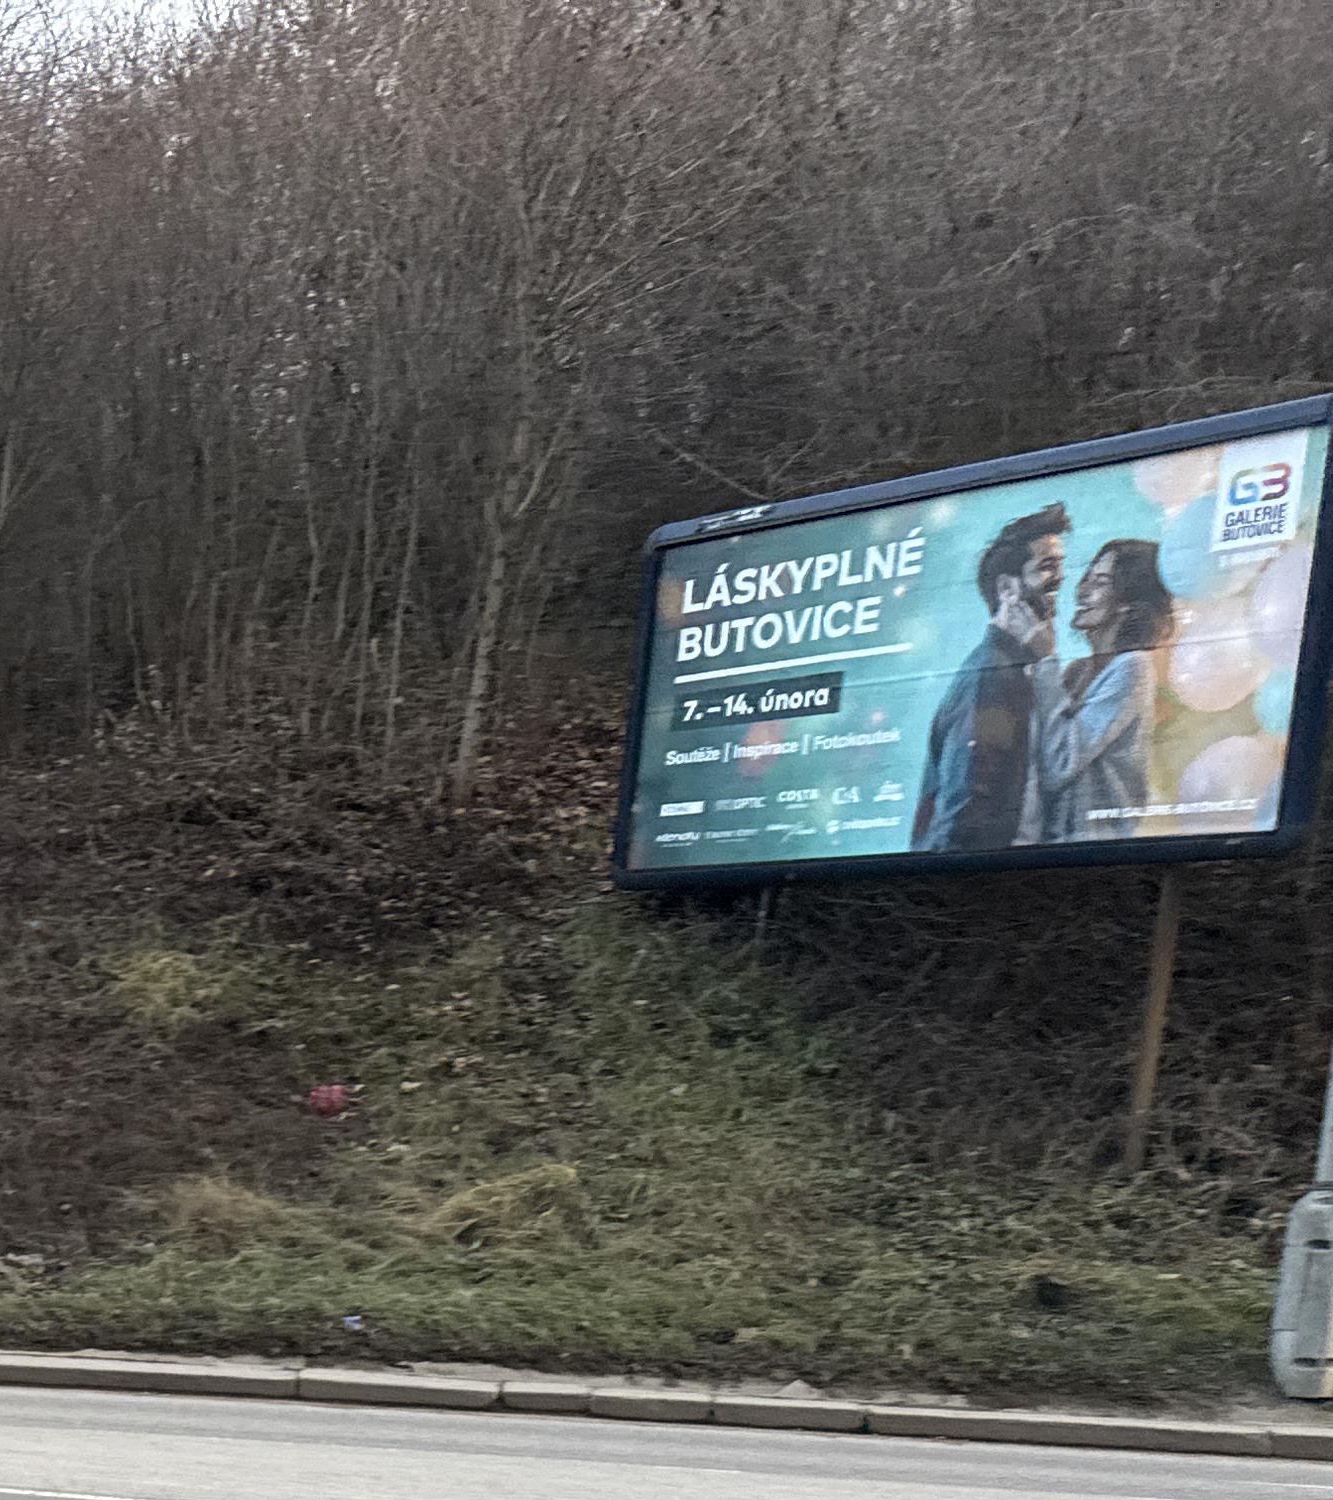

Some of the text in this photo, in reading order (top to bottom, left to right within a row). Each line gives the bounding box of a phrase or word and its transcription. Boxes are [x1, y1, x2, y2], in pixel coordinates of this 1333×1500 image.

[1225, 502, 1289, 527] GALERIE
[1221, 520, 1286, 542] BUTOVICE
[681, 526, 926, 614] LÁSKYPLNÉ
[676, 595, 883, 662] BUTOVICE
[760, 686, 831, 713] února
[733, 739, 799, 761] Inspirace
